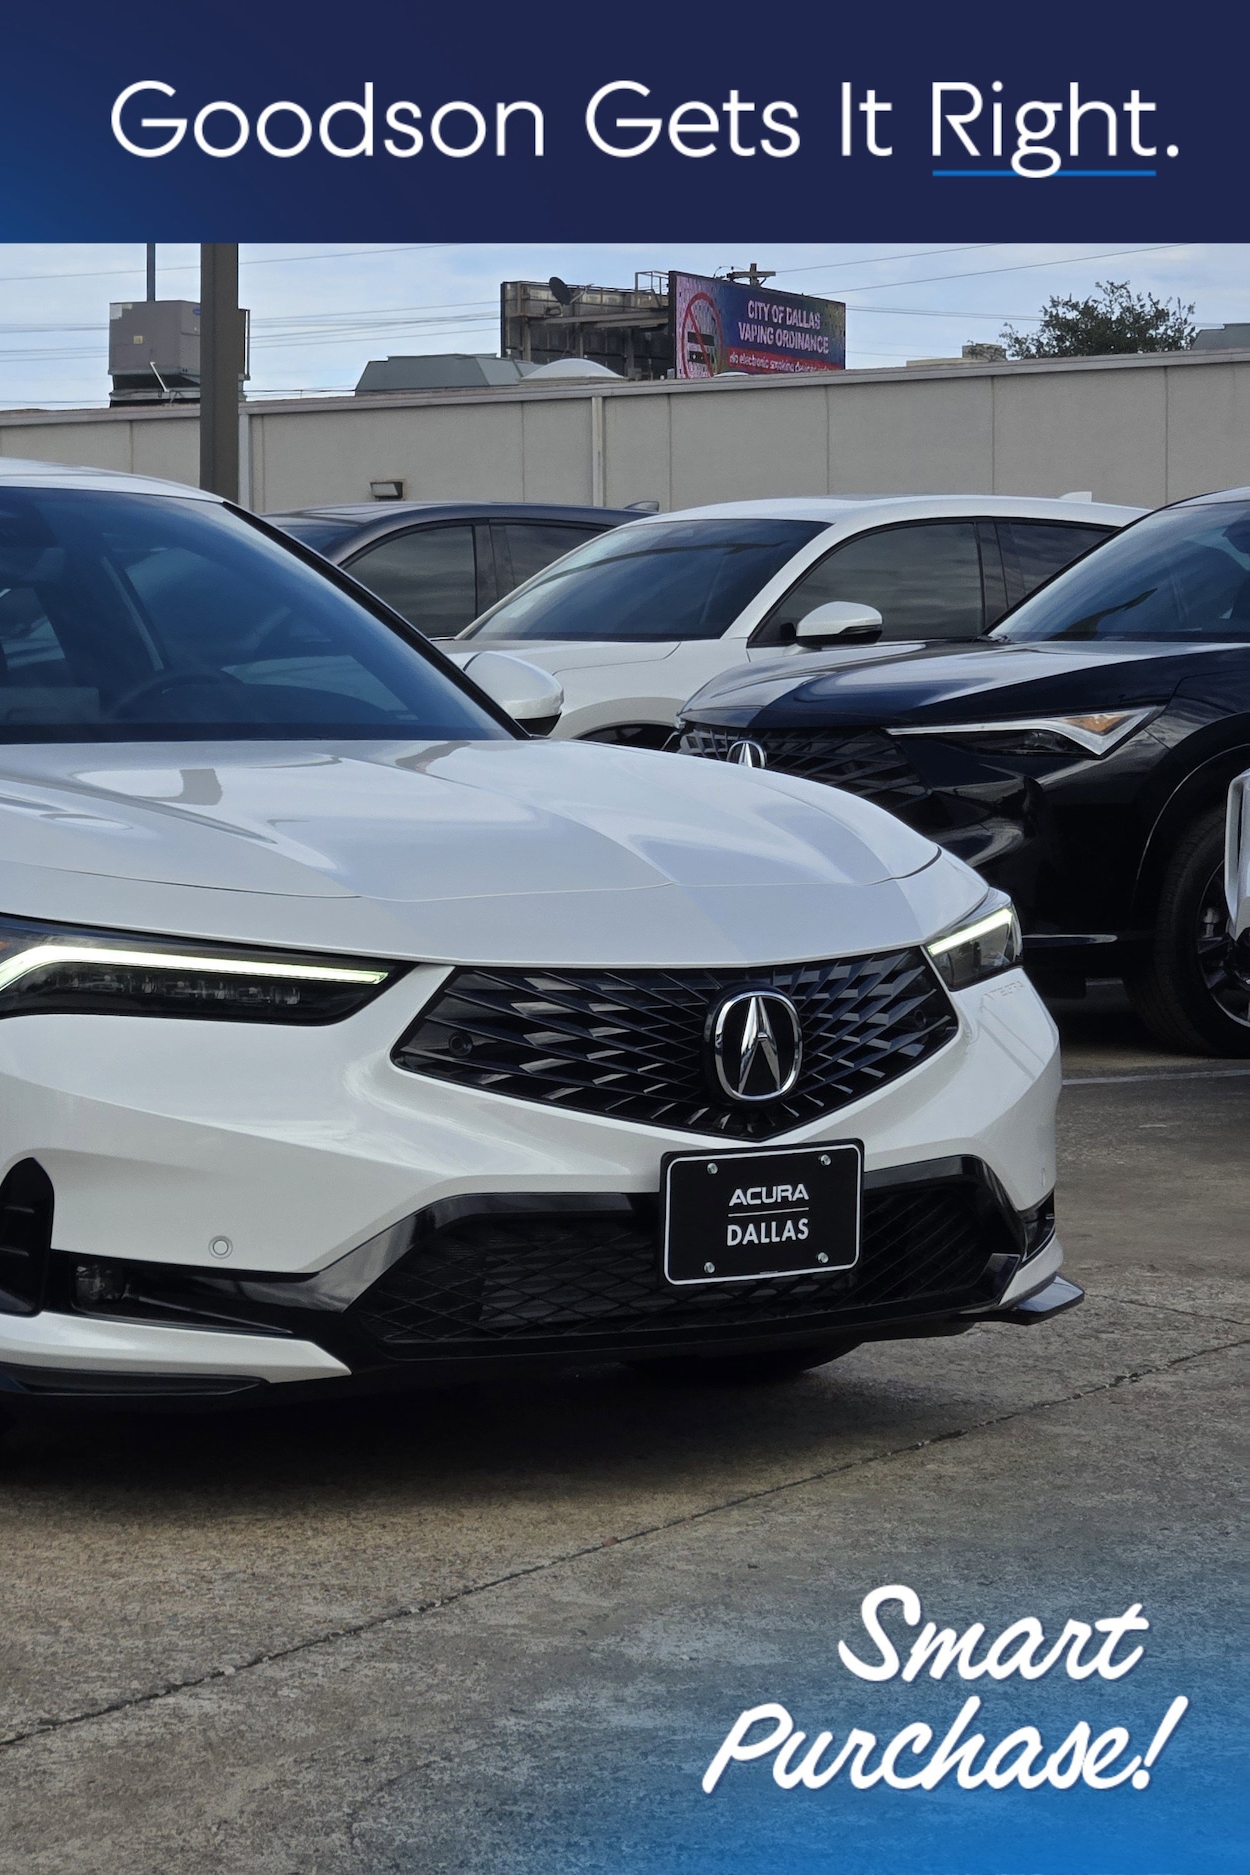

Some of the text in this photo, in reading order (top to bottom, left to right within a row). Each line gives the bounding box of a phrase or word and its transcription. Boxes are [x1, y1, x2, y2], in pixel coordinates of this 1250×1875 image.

[748, 300, 821, 330] CITY OF DALLAS
[738, 322, 829, 355] VAPING ORDINANCE
[728, 1183, 810, 1207] ACURA
[726, 1218, 810, 1247] DALLAS
